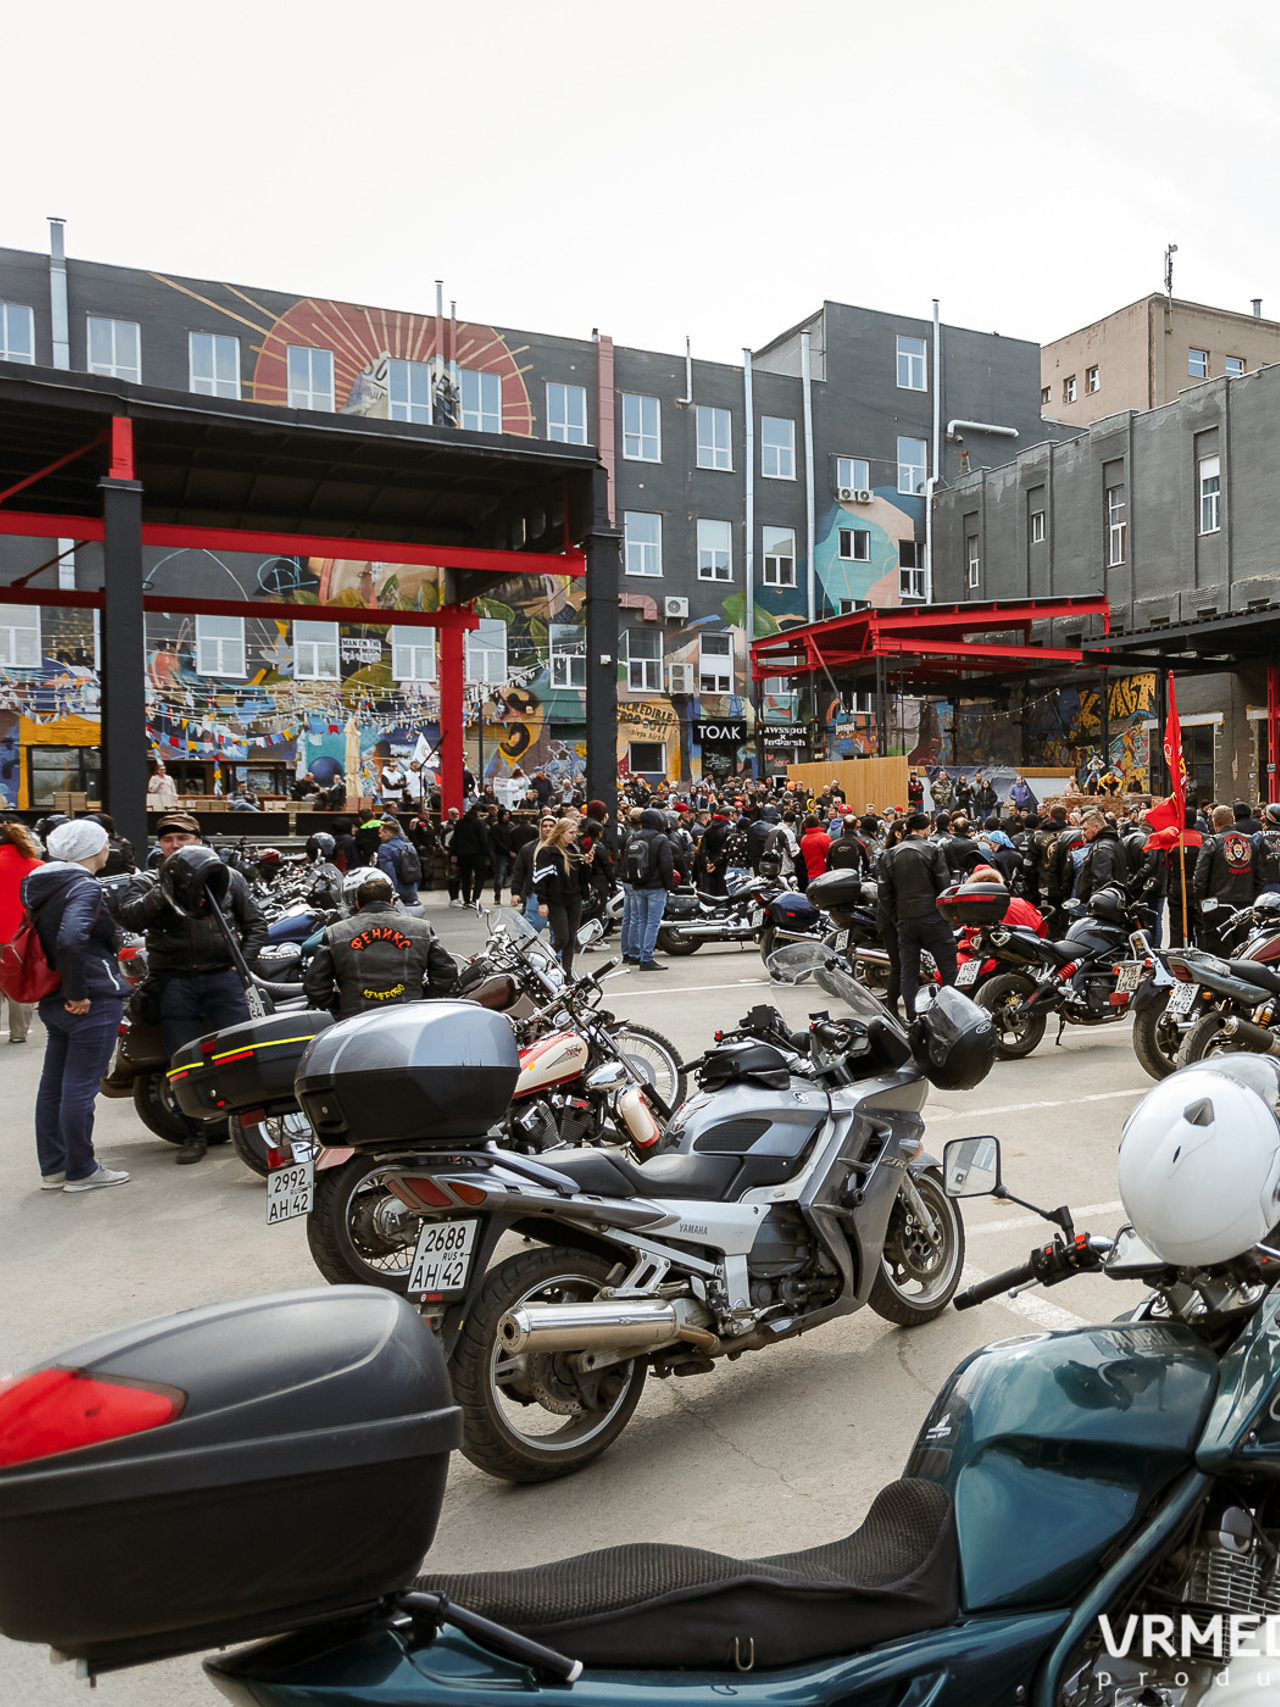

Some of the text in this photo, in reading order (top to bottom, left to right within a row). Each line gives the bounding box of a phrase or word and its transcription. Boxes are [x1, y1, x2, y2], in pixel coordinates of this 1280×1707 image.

[617, 702, 673, 722] NCREDIBLE
[350, 927, 412, 951] ФЕНИКС
[363, 983, 405, 1000] КЕМЕРОВО
[274, 1168, 306, 1194] 2992
[292, 1193, 309, 1212] 42
[679, 1223, 708, 1235] YAMAHA
[424, 1226, 466, 1253] 2688
[442, 1251, 458, 1261] RUS
[441, 1261, 464, 1287] 42
